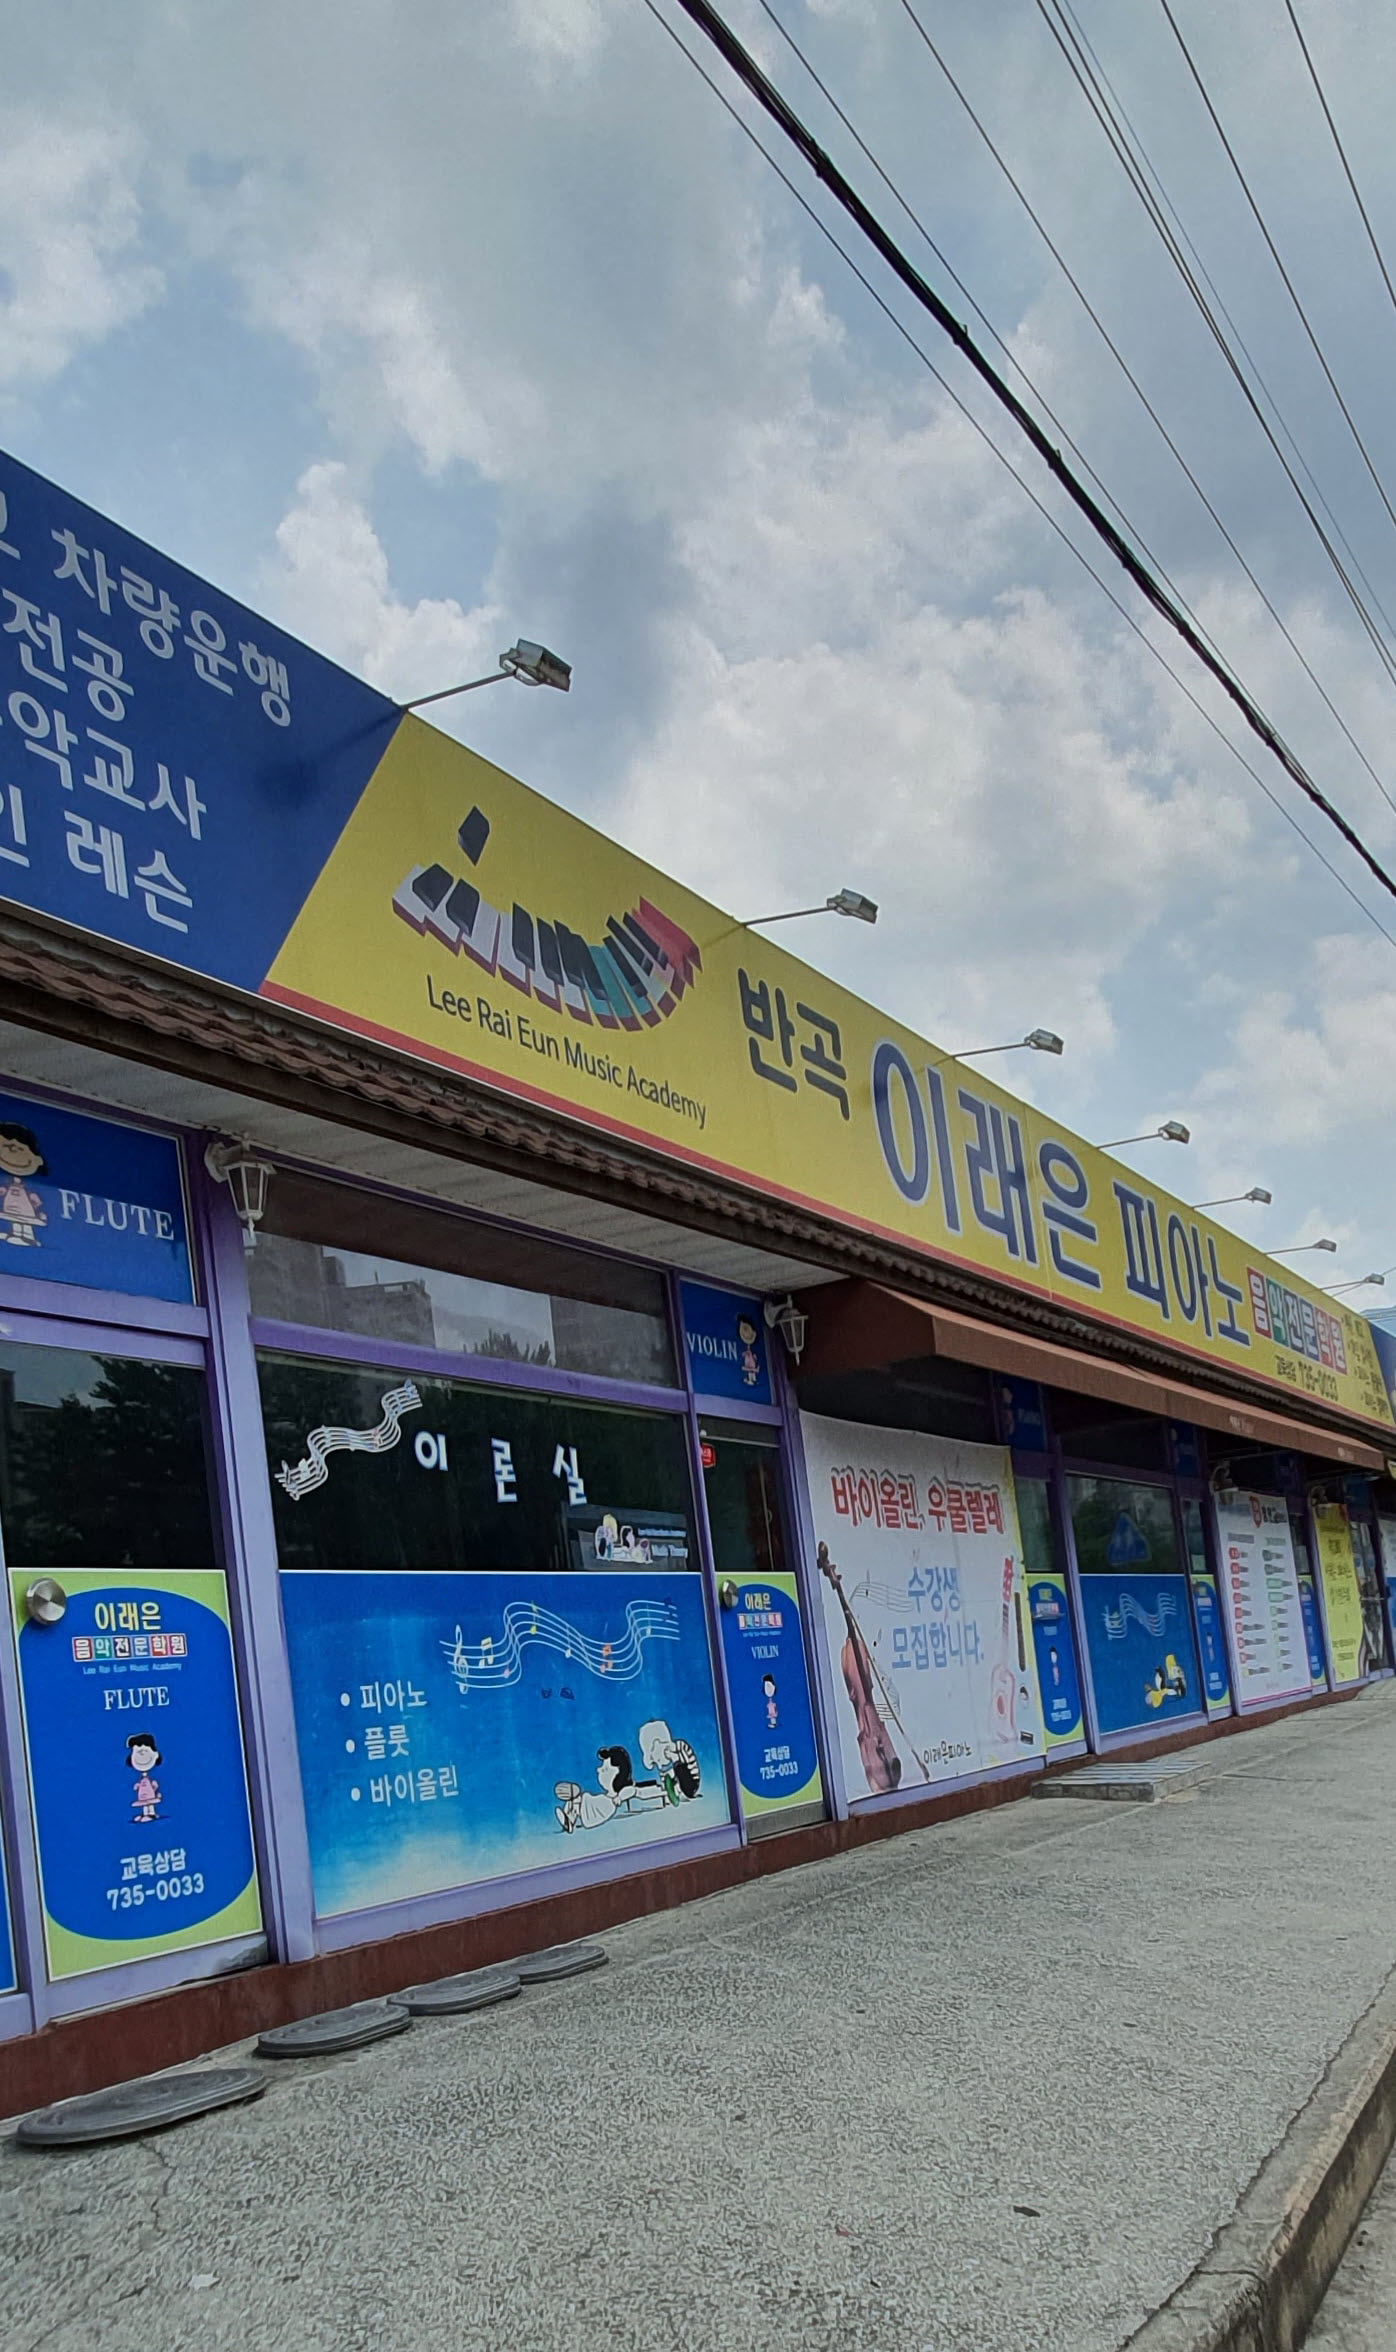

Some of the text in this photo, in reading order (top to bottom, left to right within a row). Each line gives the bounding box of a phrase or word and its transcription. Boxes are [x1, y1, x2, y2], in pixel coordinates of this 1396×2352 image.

[51, 527, 291, 727] 차량운행
[0, 691, 207, 840] 악교사
[64, 809, 193, 934] 레슨
[426, 974, 707, 1130] Lee Rai Eun Music Academy
[737, 967, 851, 1122] 반곡
[870, 1038, 1103, 1291] 이래은
[1113, 1178, 1251, 1348] 피아노
[58, 1188, 175, 1241] FLUTE
[686, 1331, 739, 1363] VIOLIN
[907, 1565, 961, 1613] 수강생
[94, 1601, 162, 1632] 이래은
[74, 1634, 186, 1661] 음악전문학원
[750, 1644, 780, 1661] VIOLIN
[103, 1686, 170, 1710] FLUTE
[359, 1677, 428, 1714] 피아노
[363, 1723, 411, 1760] 플룻
[369, 1763, 460, 1808] 바이올린
[760, 1761, 799, 1780] 735-0033
[120, 1848, 186, 1881] 교육상담
[106, 1872, 205, 1911] 735-0033
